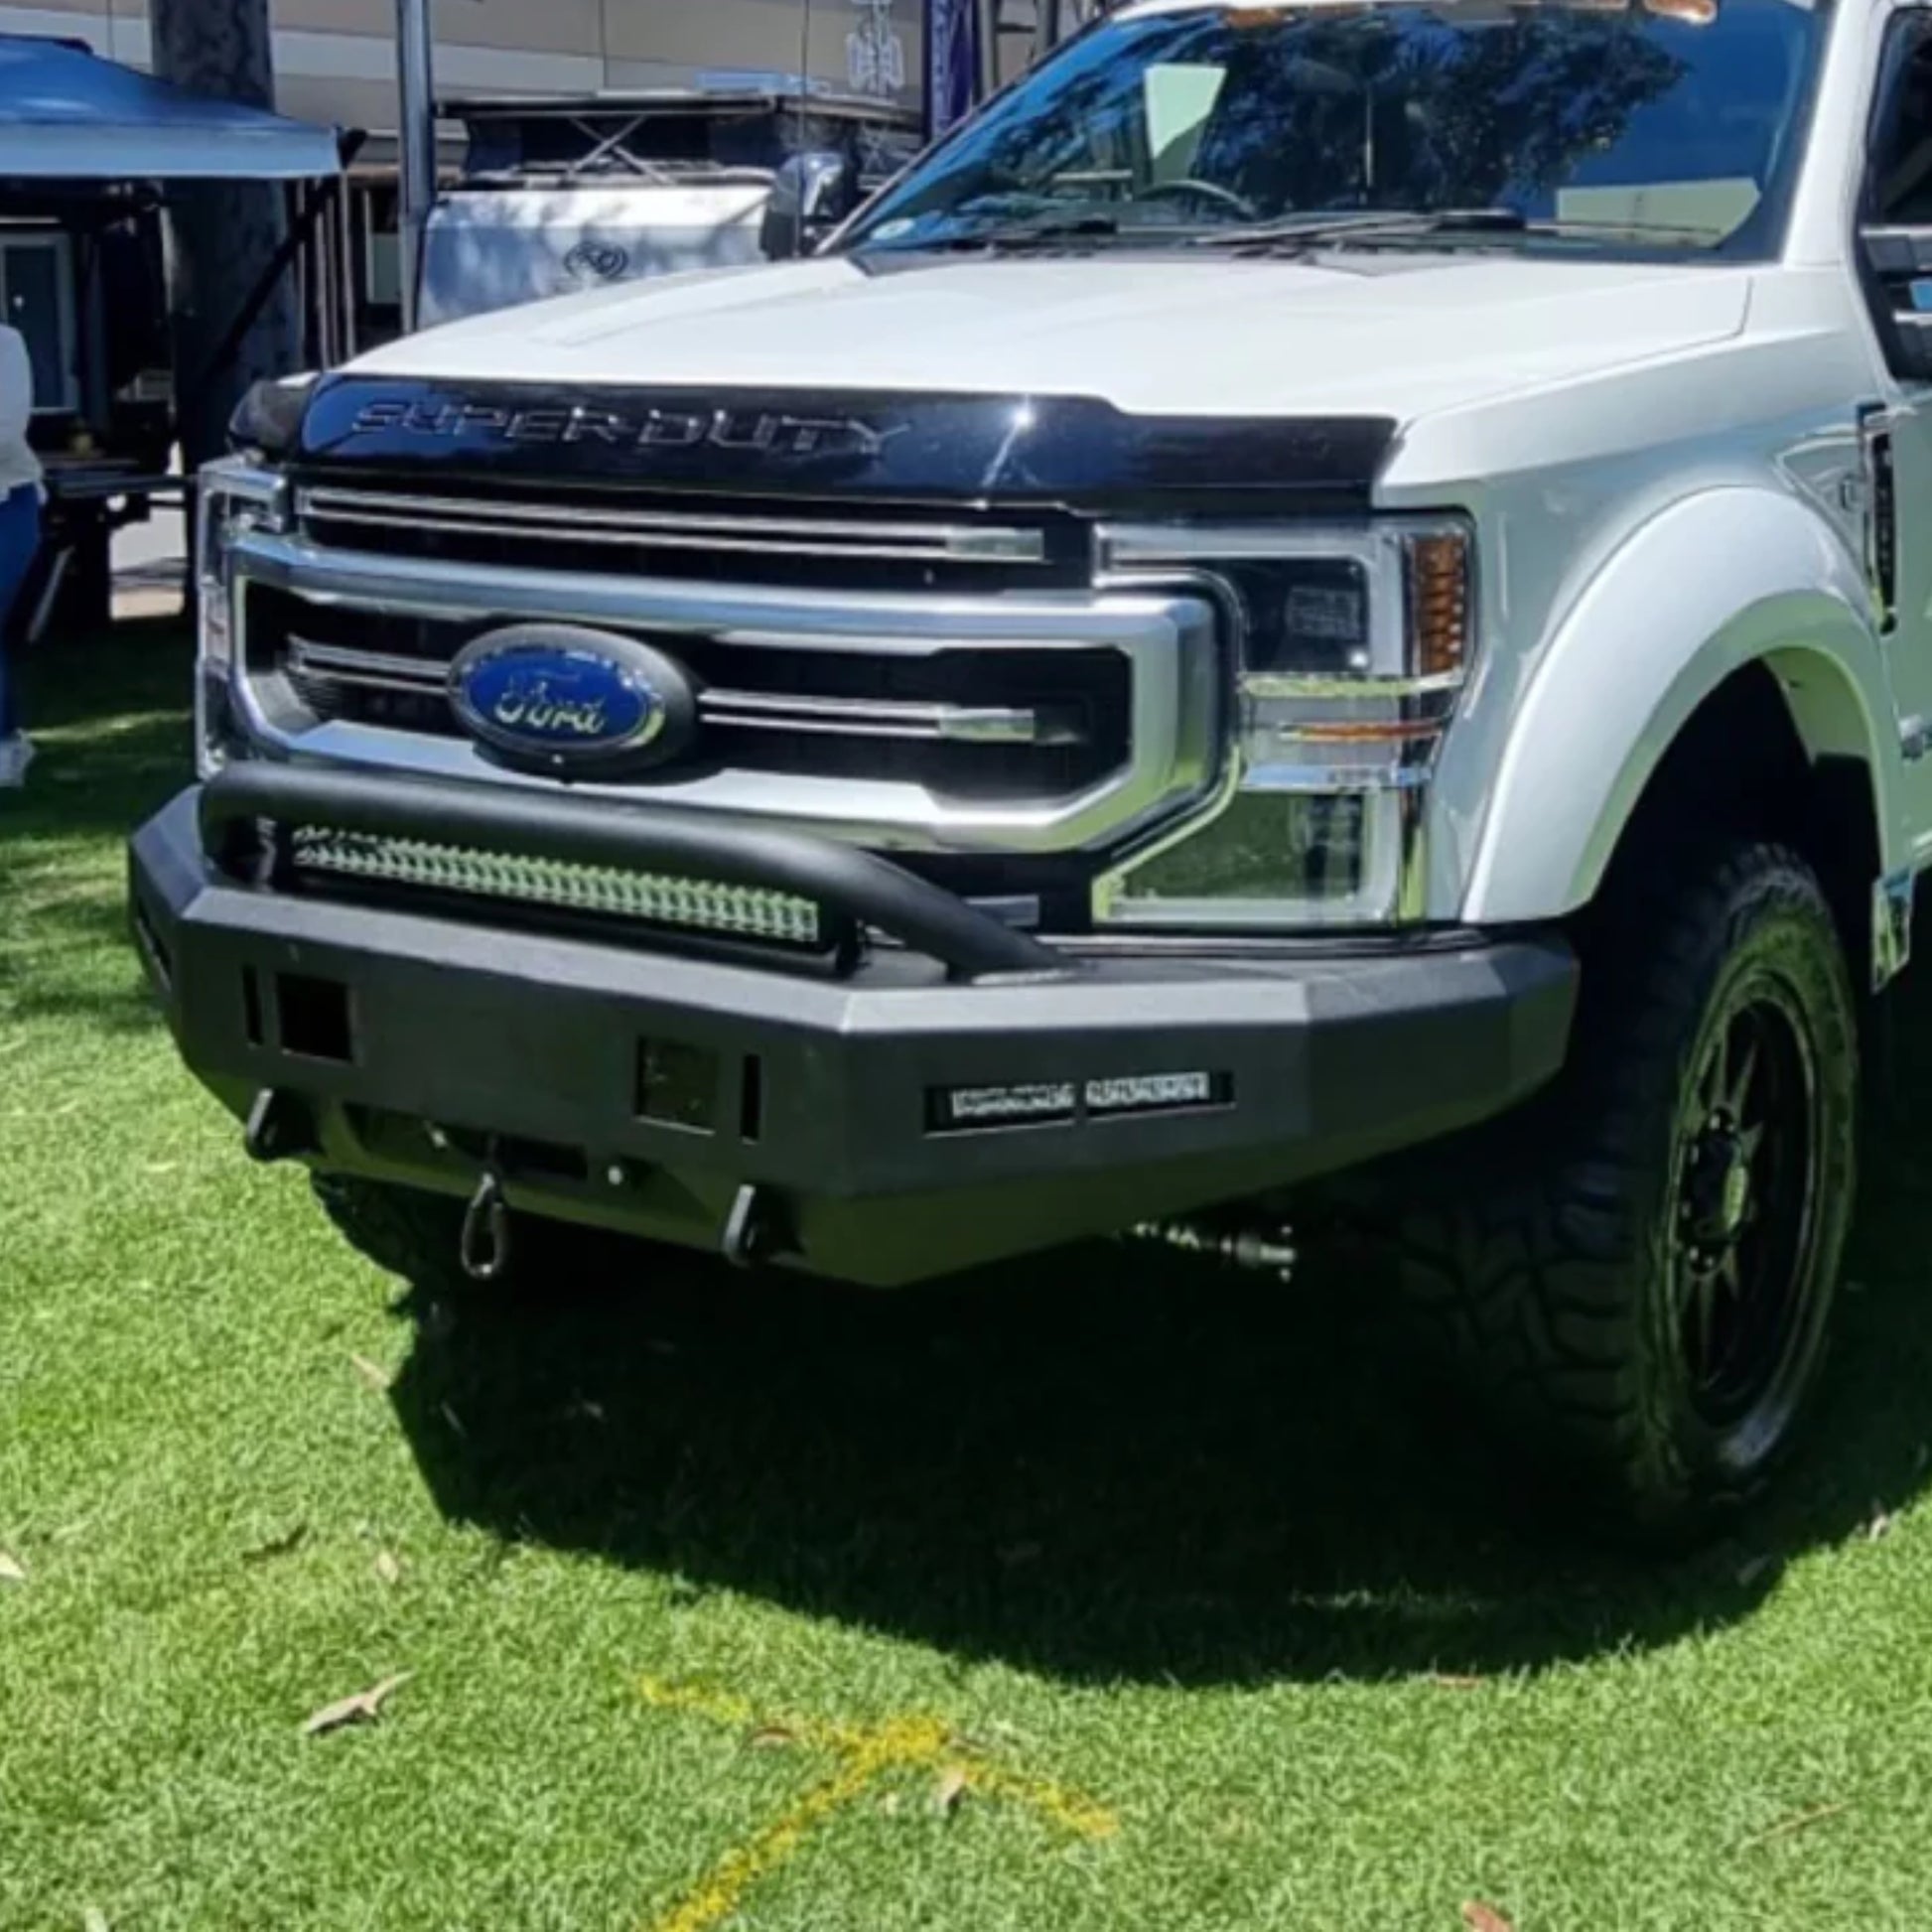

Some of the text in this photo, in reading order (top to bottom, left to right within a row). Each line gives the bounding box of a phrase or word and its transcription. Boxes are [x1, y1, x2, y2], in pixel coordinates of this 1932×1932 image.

[350, 402, 912, 454] SUPER DUTY
[494, 677, 607, 735] Ford
